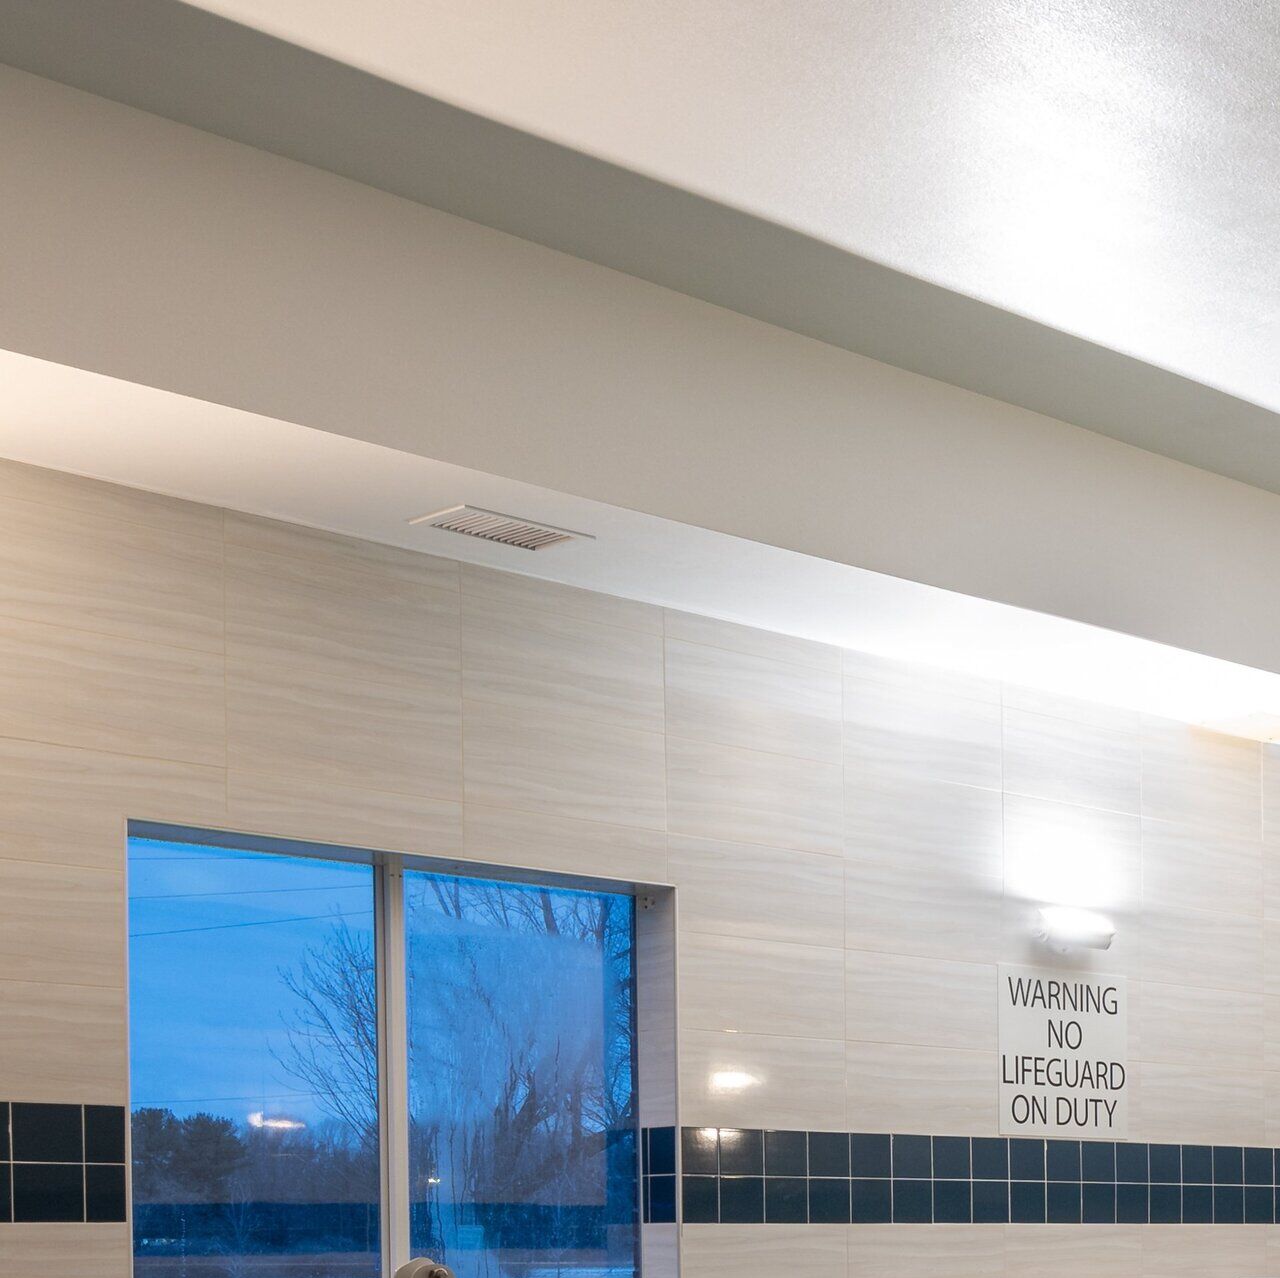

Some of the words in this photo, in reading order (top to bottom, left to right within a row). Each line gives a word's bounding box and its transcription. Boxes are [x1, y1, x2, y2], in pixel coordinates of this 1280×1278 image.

[1008, 976, 1118, 1015] WARNING
[1048, 1019, 1082, 1049] NO
[1002, 1054, 1126, 1090] LIFEGUARD
[1011, 1094, 1047, 1125] ON
[1056, 1097, 1117, 1127] DUTY
